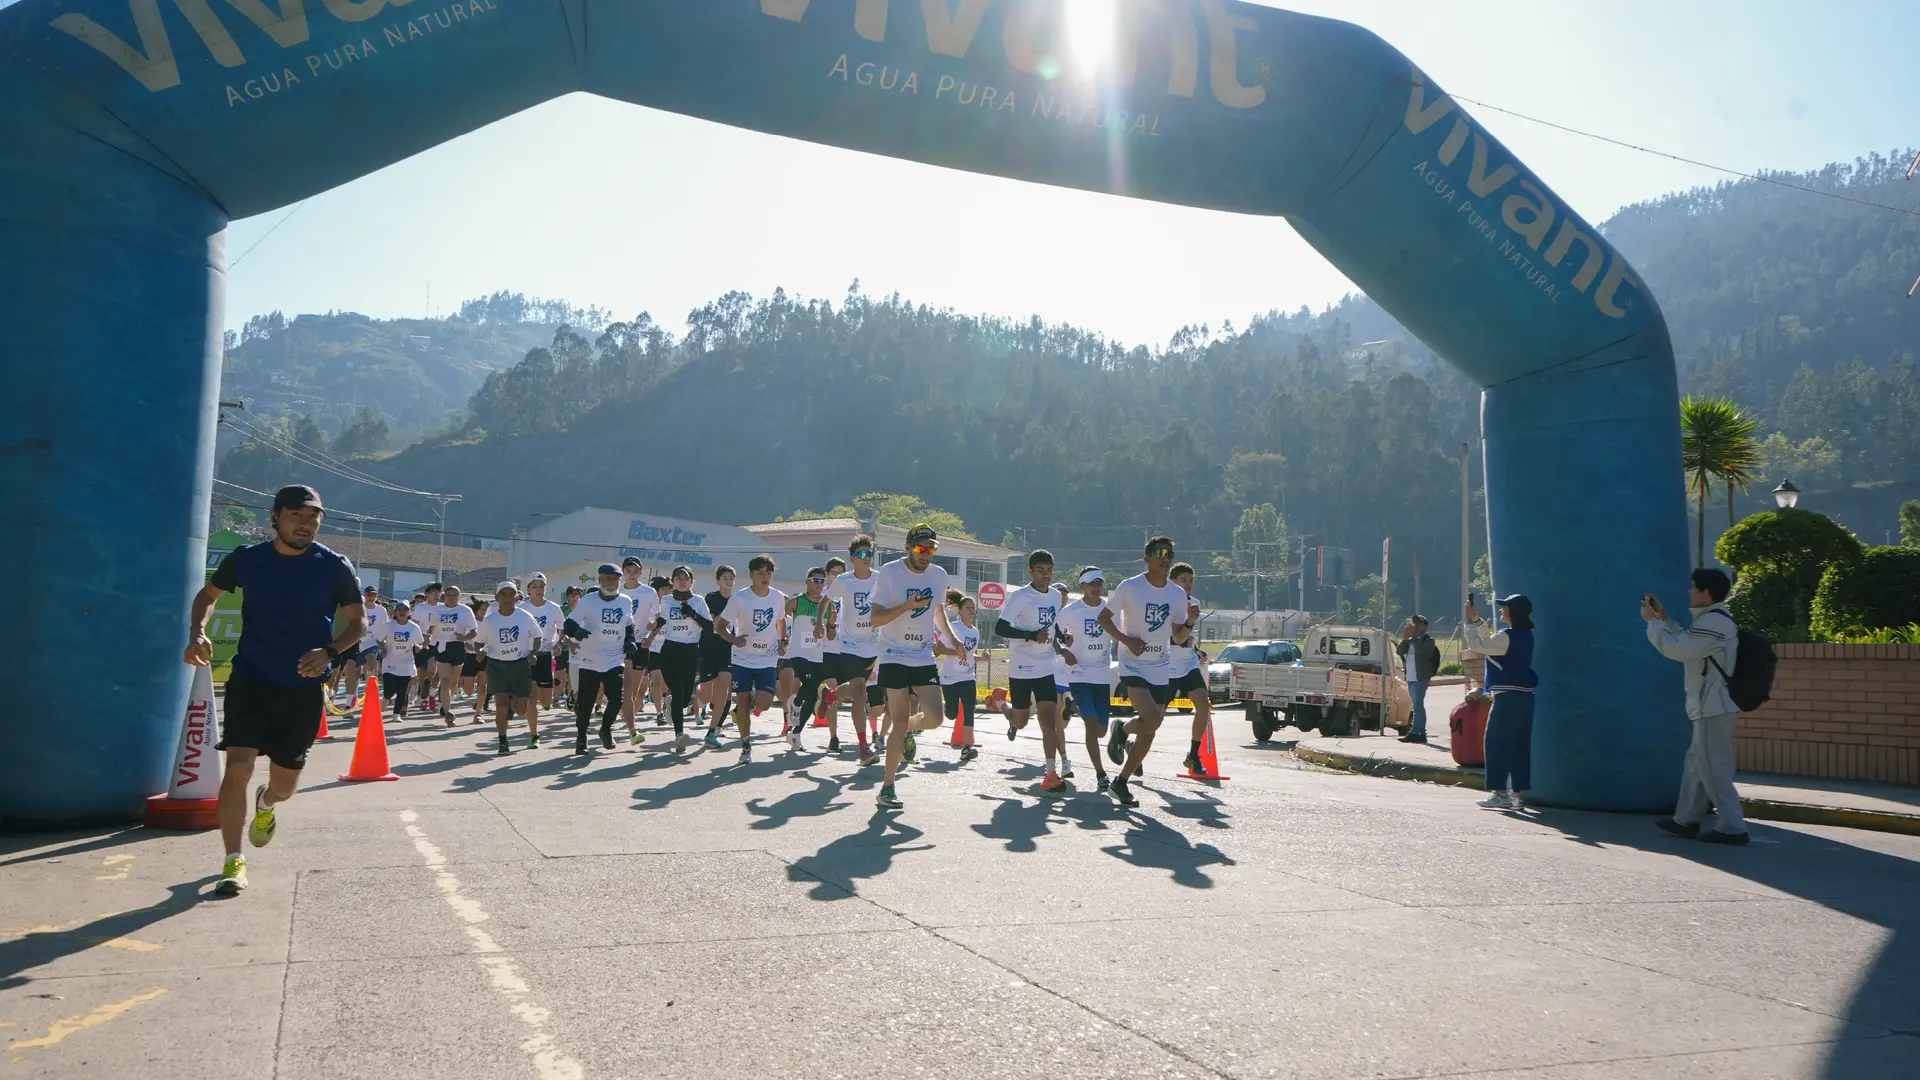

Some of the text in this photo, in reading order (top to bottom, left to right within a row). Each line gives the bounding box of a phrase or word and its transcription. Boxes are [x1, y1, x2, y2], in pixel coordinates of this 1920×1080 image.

[225, 0, 498, 107] AGUA PURA NATURAL
[828, 53, 1162, 137] AGUA PURA NATURAL
[1413, 160, 1563, 304] AGUA PURA NATURAL
[628, 519, 706, 546] Baxter
[602, 611, 619, 622] 5K
[754, 615, 769, 625] 5K
[1039, 613, 1053, 624] 5K
[1146, 610, 1164, 623] 5K
[1085, 624, 1102, 634] 5K
[500, 633, 515, 643] 5K
[904, 633, 924, 642] 0145
[501, 647, 518, 655] 0449
[1145, 645, 1162, 653] 0105
[176, 700, 207, 787] Vivant
